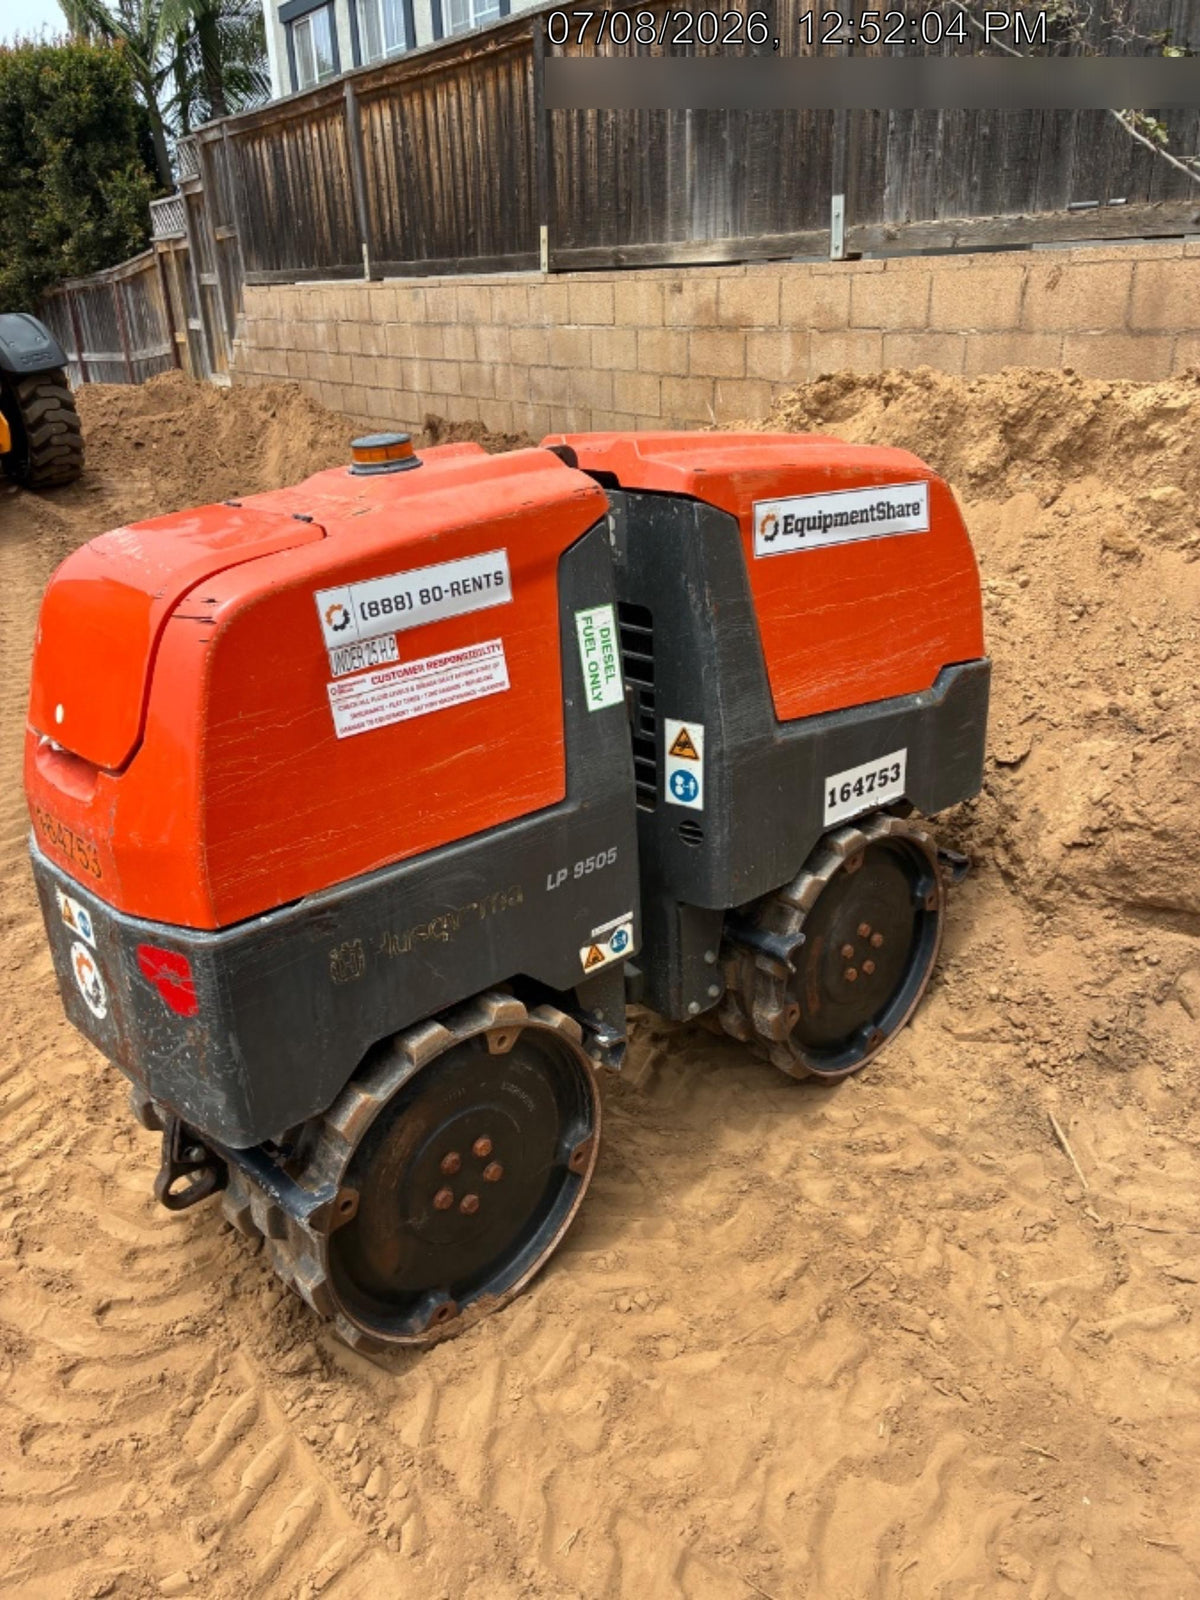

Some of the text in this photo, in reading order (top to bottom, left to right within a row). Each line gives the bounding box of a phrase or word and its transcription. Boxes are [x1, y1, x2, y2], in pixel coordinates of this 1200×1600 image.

[782, 500, 922, 538] EquipmentShare
[360, 570, 504, 622] (888) 80-RENTS
[371, 664, 425, 686] CUSTOMER
[426, 643, 502, 670] RESPONSIBILITY
[581, 615, 604, 702] FUEL ONLY
[599, 626, 616, 685] DIESEL
[828, 762, 901, 809] 164753
[546, 846, 618, 892] LP 9505
